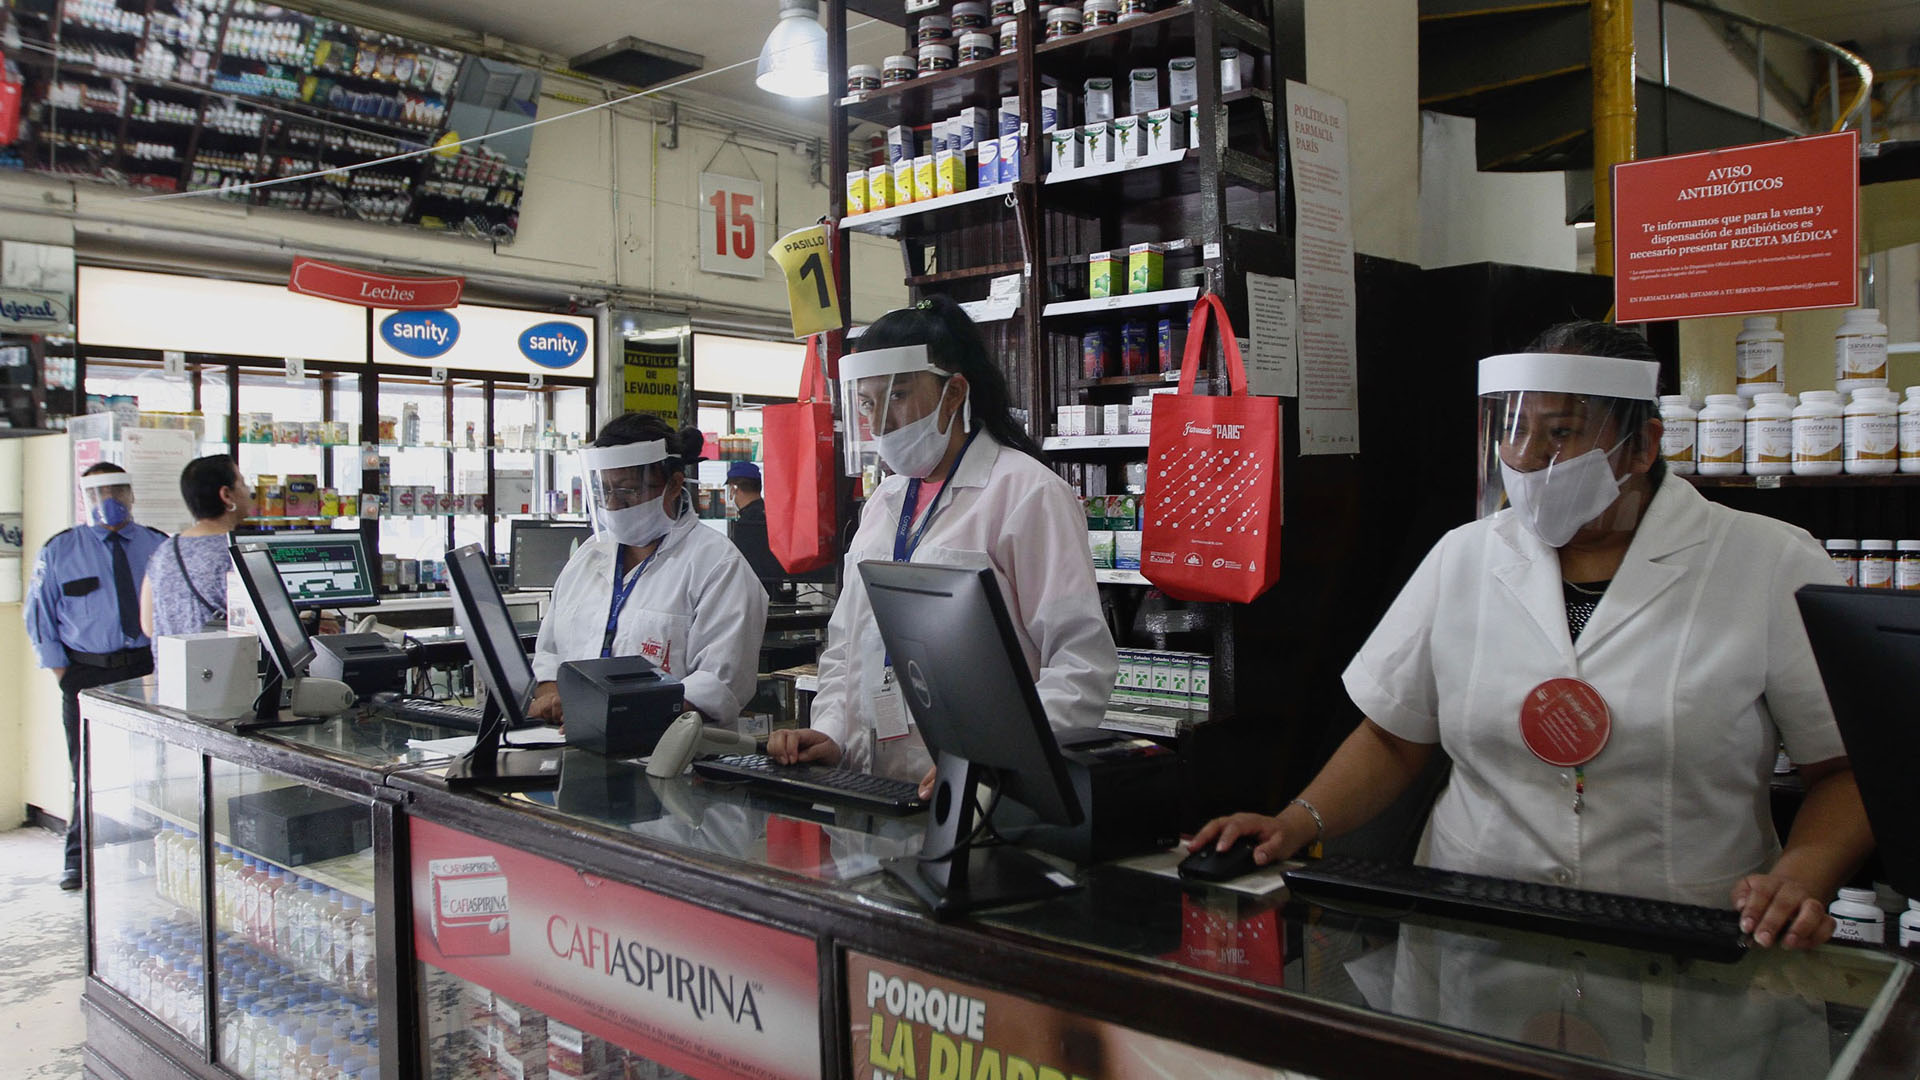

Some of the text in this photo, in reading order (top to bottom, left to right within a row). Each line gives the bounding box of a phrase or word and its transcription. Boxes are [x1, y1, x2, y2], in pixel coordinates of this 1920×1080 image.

[1294, 104, 1328, 125] POLÍTICA
[1295, 121, 1334, 142] FARMACIA
[1296, 137, 1319, 153] PARÍS
[1706, 164, 1752, 182] AVISO
[1677, 176, 1784, 201] ANTIBIÓTICOS
[709, 189, 756, 260] 15
[1642, 204, 1824, 233] Te informamos que para la venta y
[1651, 219, 1813, 245] dispensación de antibióticos es
[784, 235, 825, 253] PASILLO
[1630, 246, 1677, 260] necesario
[1679, 241, 1728, 257] presentar
[1731, 237, 1778, 250] RECETA
[360, 281, 416, 301] Leches
[799, 252, 832, 309] 1
[1639, 293, 1669, 302] FARMACIA
[393, 319, 449, 346] sanity
[529, 332, 577, 356] sanity
[288, 362, 298, 376] 3
[627, 353, 677, 366] PASTILLAS
[646, 369, 657, 379] DE
[624, 381, 678, 396] LEVADURA
[443, 862, 497, 873] CAFIASPIRINA
[450, 896, 508, 913] CAFIASPIRINA
[546, 914, 764, 1033] CAFIASPIRINA
[867, 969, 986, 1042] PORQUE
[868, 1012, 917, 1079] LA
